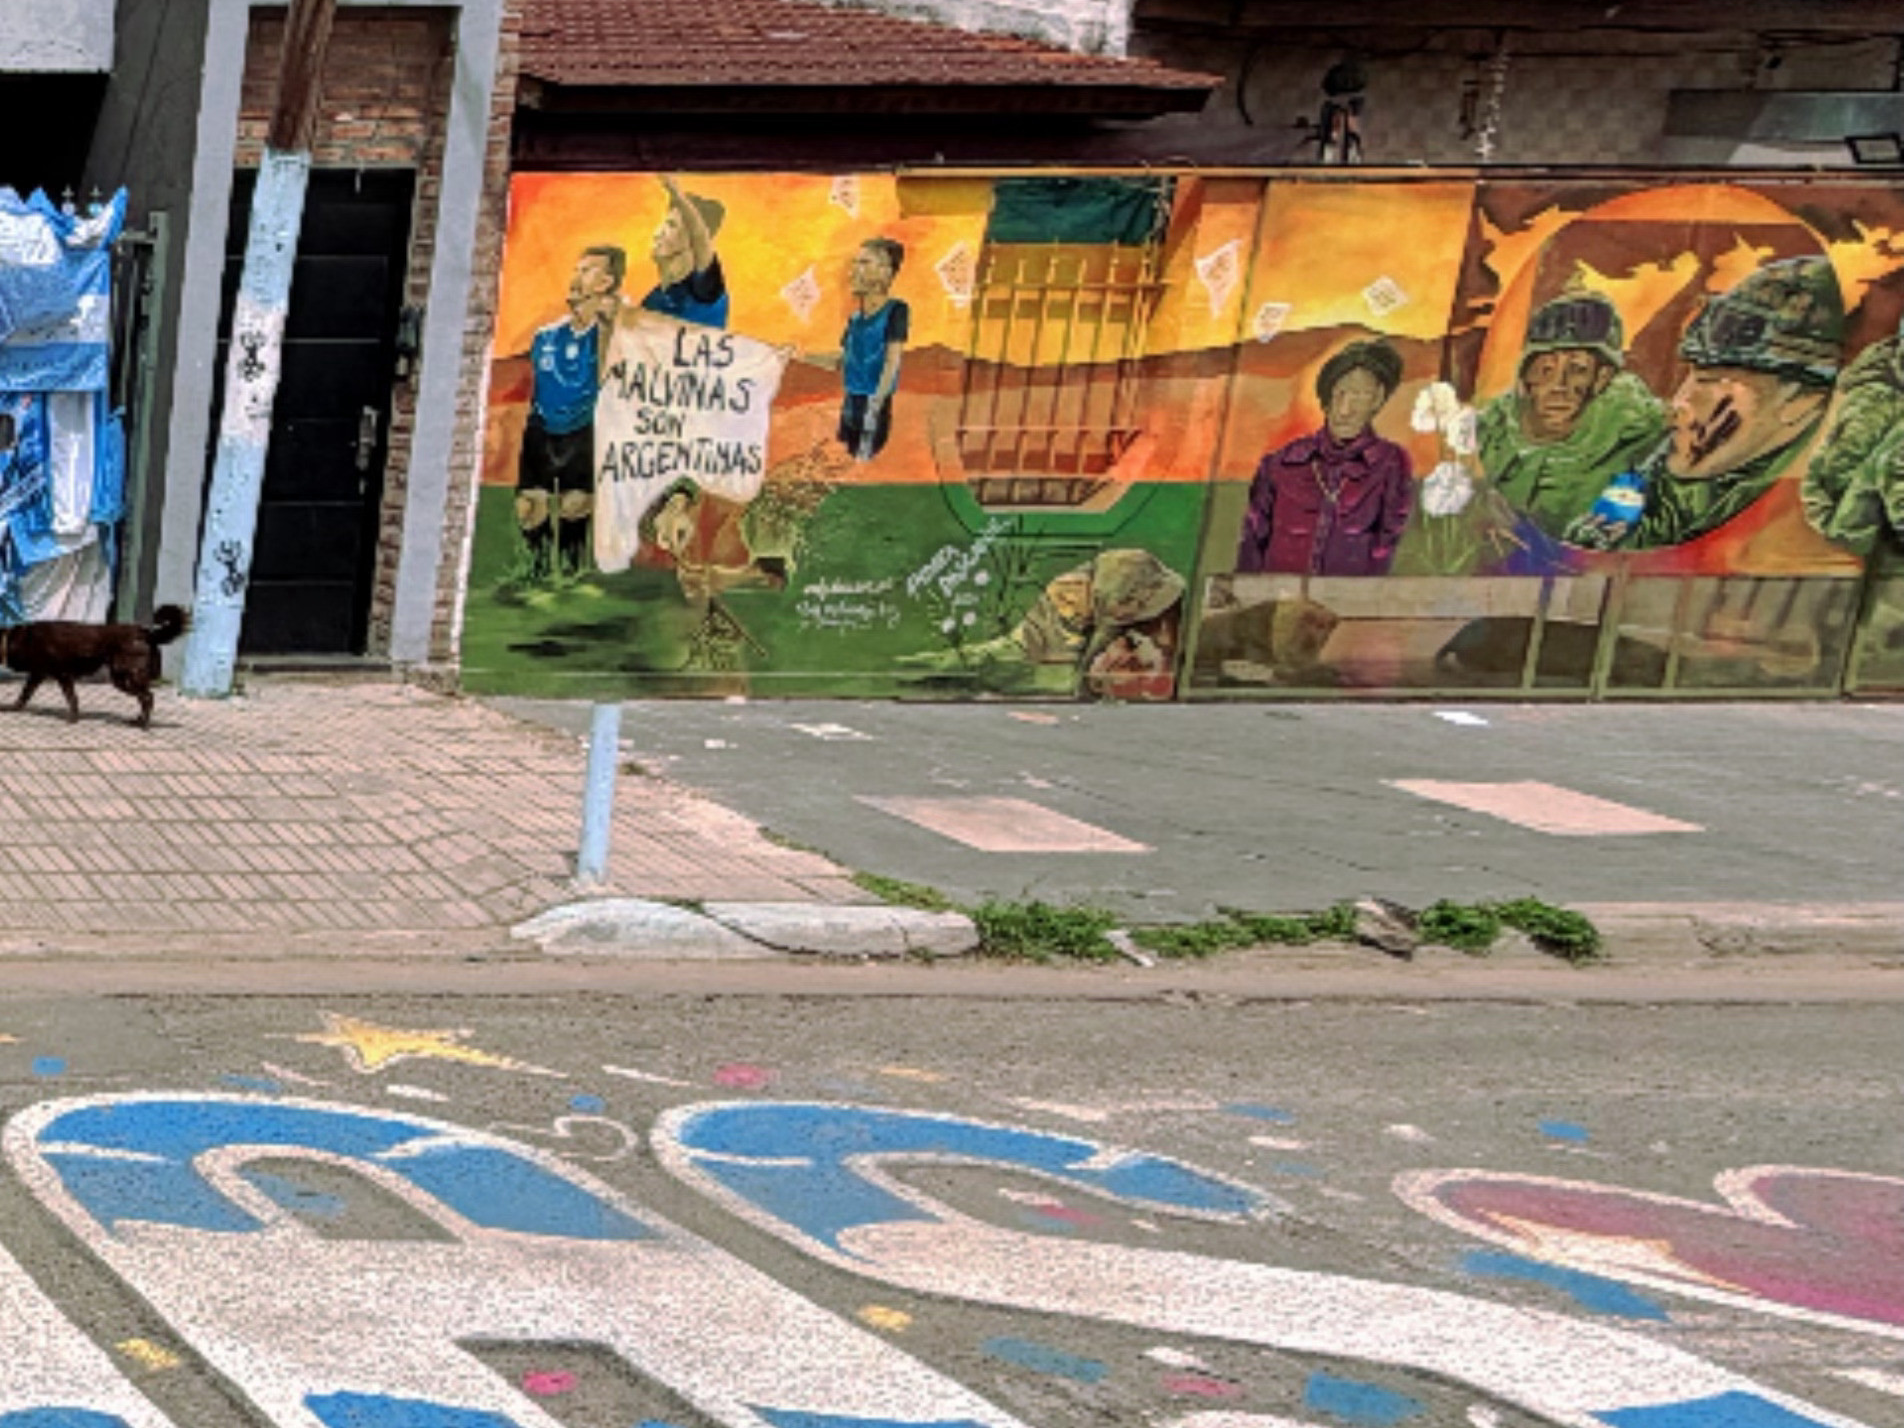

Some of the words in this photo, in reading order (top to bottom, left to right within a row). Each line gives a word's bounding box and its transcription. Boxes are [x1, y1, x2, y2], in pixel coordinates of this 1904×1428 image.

[672, 325, 735, 368] LAS
[608, 358, 758, 414] MALVINAS
[633, 406, 688, 438] SON
[598, 437, 762, 483] ARGENTINAS
